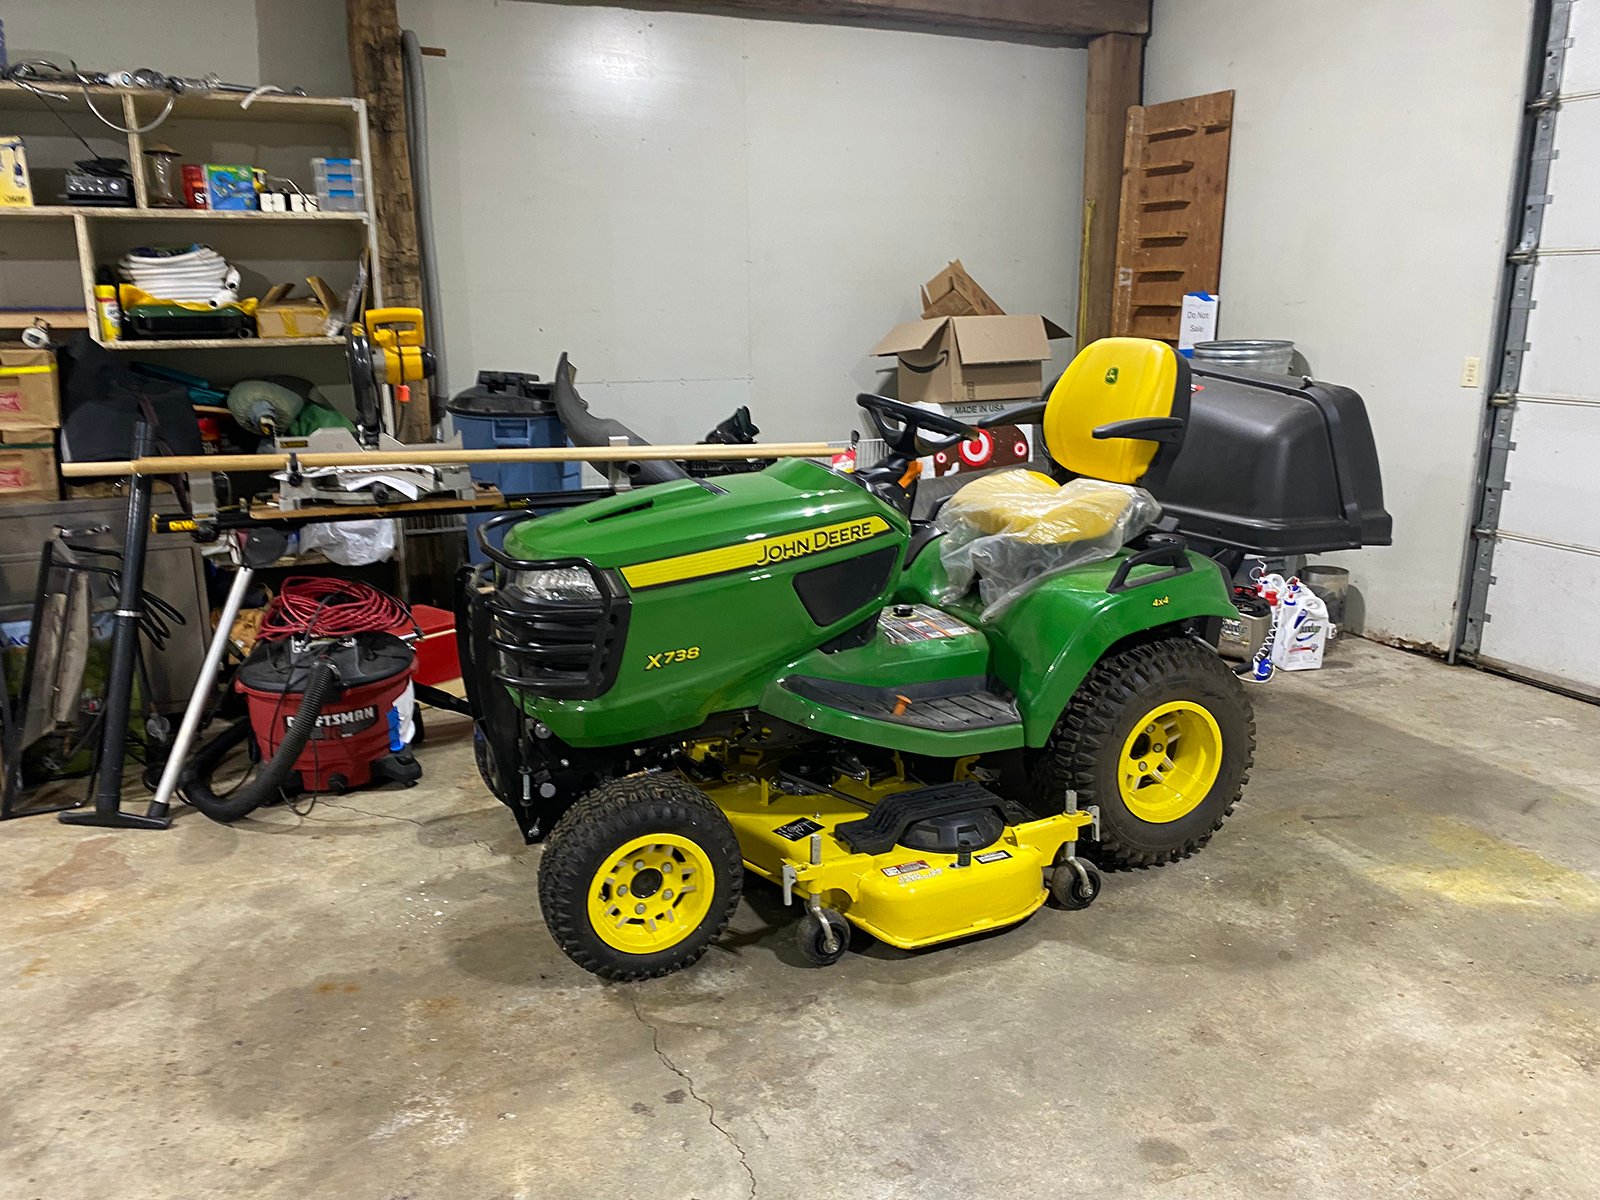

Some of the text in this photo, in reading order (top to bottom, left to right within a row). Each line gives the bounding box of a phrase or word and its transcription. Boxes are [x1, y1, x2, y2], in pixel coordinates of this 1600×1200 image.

[954, 403, 1005, 414] MADE IN USA
[756, 521, 872, 565] JOHN DEERE
[1152, 595, 1169, 607] 4x4
[644, 645, 701, 671] X738
[286, 706, 375, 728] CFTSMAN
